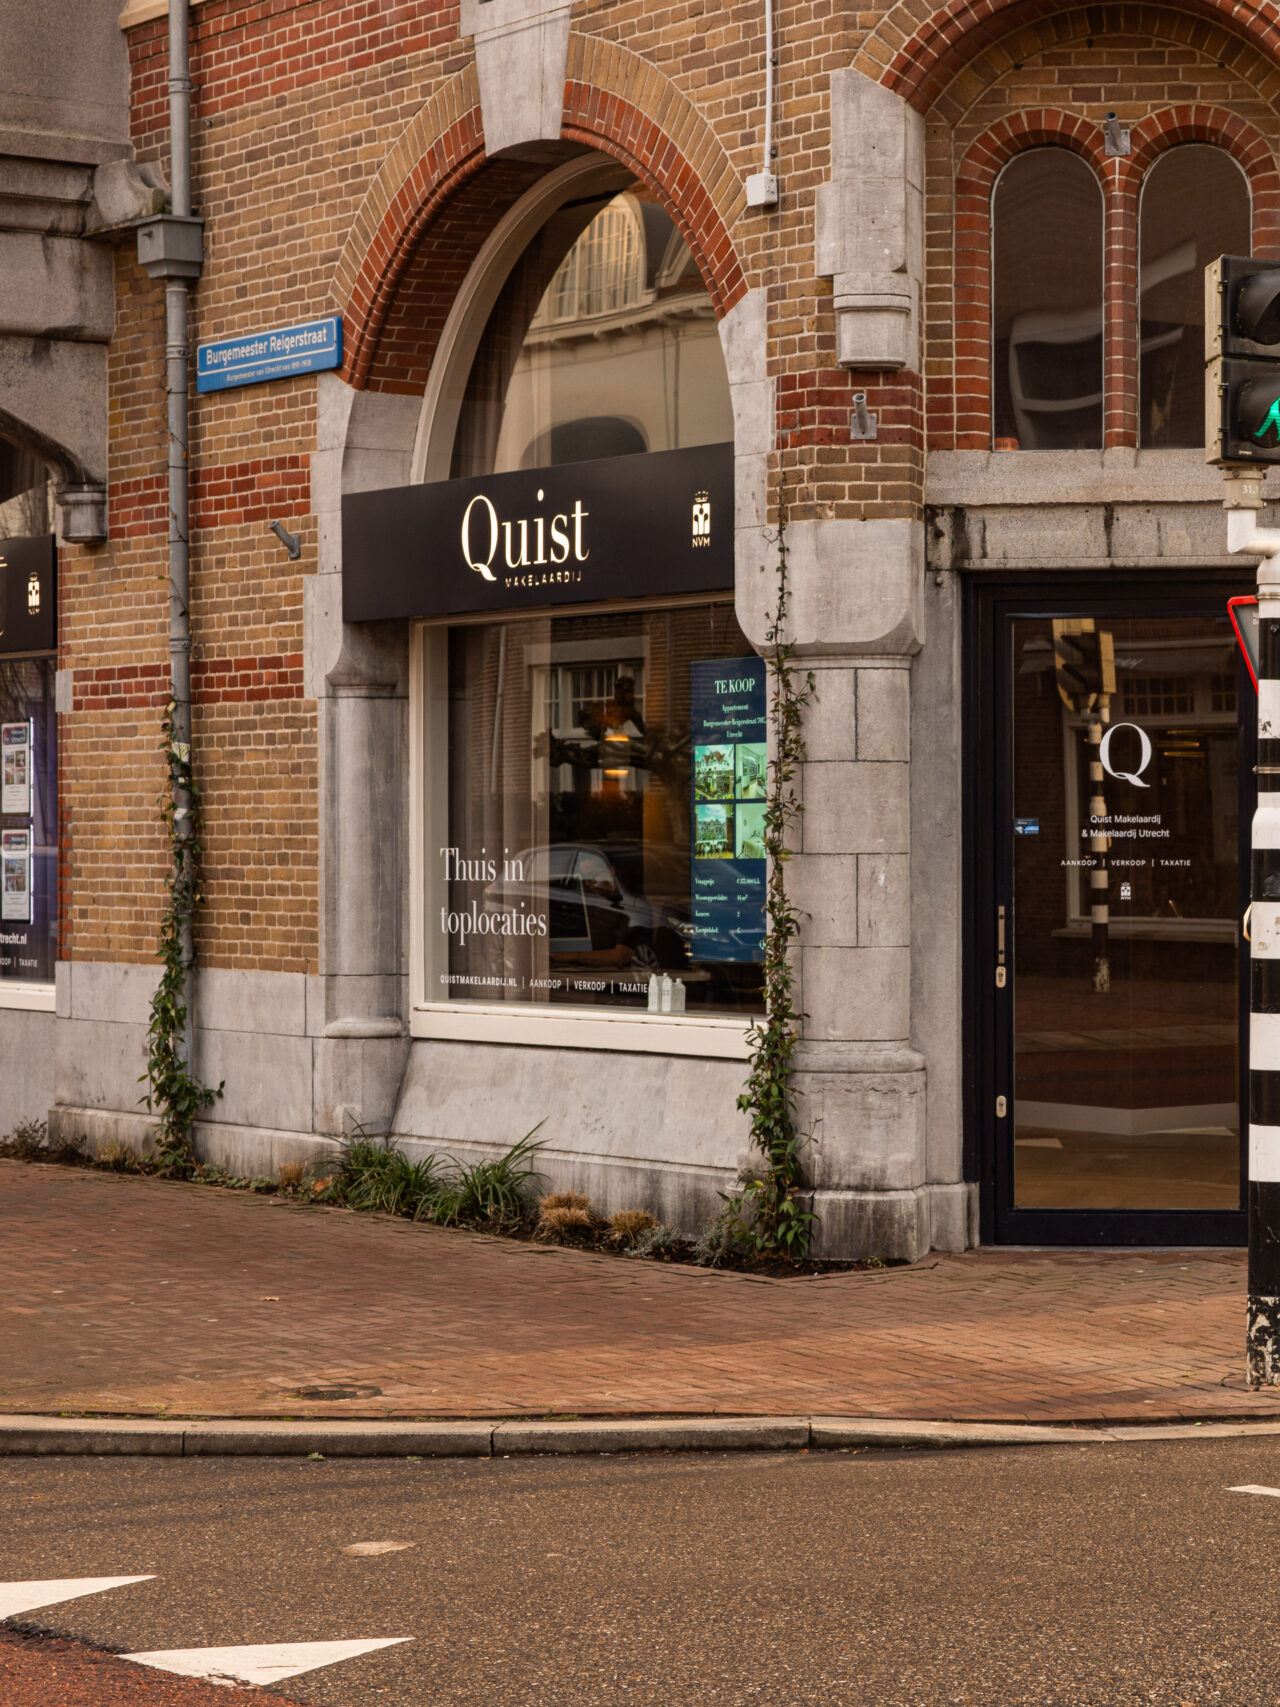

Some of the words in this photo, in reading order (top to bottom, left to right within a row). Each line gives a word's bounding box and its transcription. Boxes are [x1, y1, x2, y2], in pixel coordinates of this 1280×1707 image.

[206, 341, 268, 366] Burgemeester
[270, 326, 328, 354] Reigerstraat
[461, 489, 590, 581] Quist
[692, 537, 711, 548] NVM
[505, 570, 582, 588] MAKELAARDIJ
[714, 680, 728, 694] TE
[729, 678, 755, 693] KOOP
[1099, 722, 1152, 787] Q
[1090, 815, 1112, 824] Quist
[1114, 815, 1161, 825] Makelaardij
[1081, 829, 1088, 838] &
[1090, 829, 1137, 839] Makelaardij
[1139, 829, 1170, 838] Utrecht
[440, 848, 497, 881] Thuis
[504, 848, 525, 881] in
[1060, 859, 1097, 867] AANKOOP
[1111, 859, 1146, 867] VERKOOP
[1160, 859, 1191, 867] TAXATIE
[440, 900, 547, 946] toplocaties
[440, 975, 518, 987] QUISTMAKELAARDIJ.NL
[529, 979, 561, 989] AANKOOP
[574, 980, 606, 991] VERKOOP
[619, 982, 648, 993] TAXATIE
